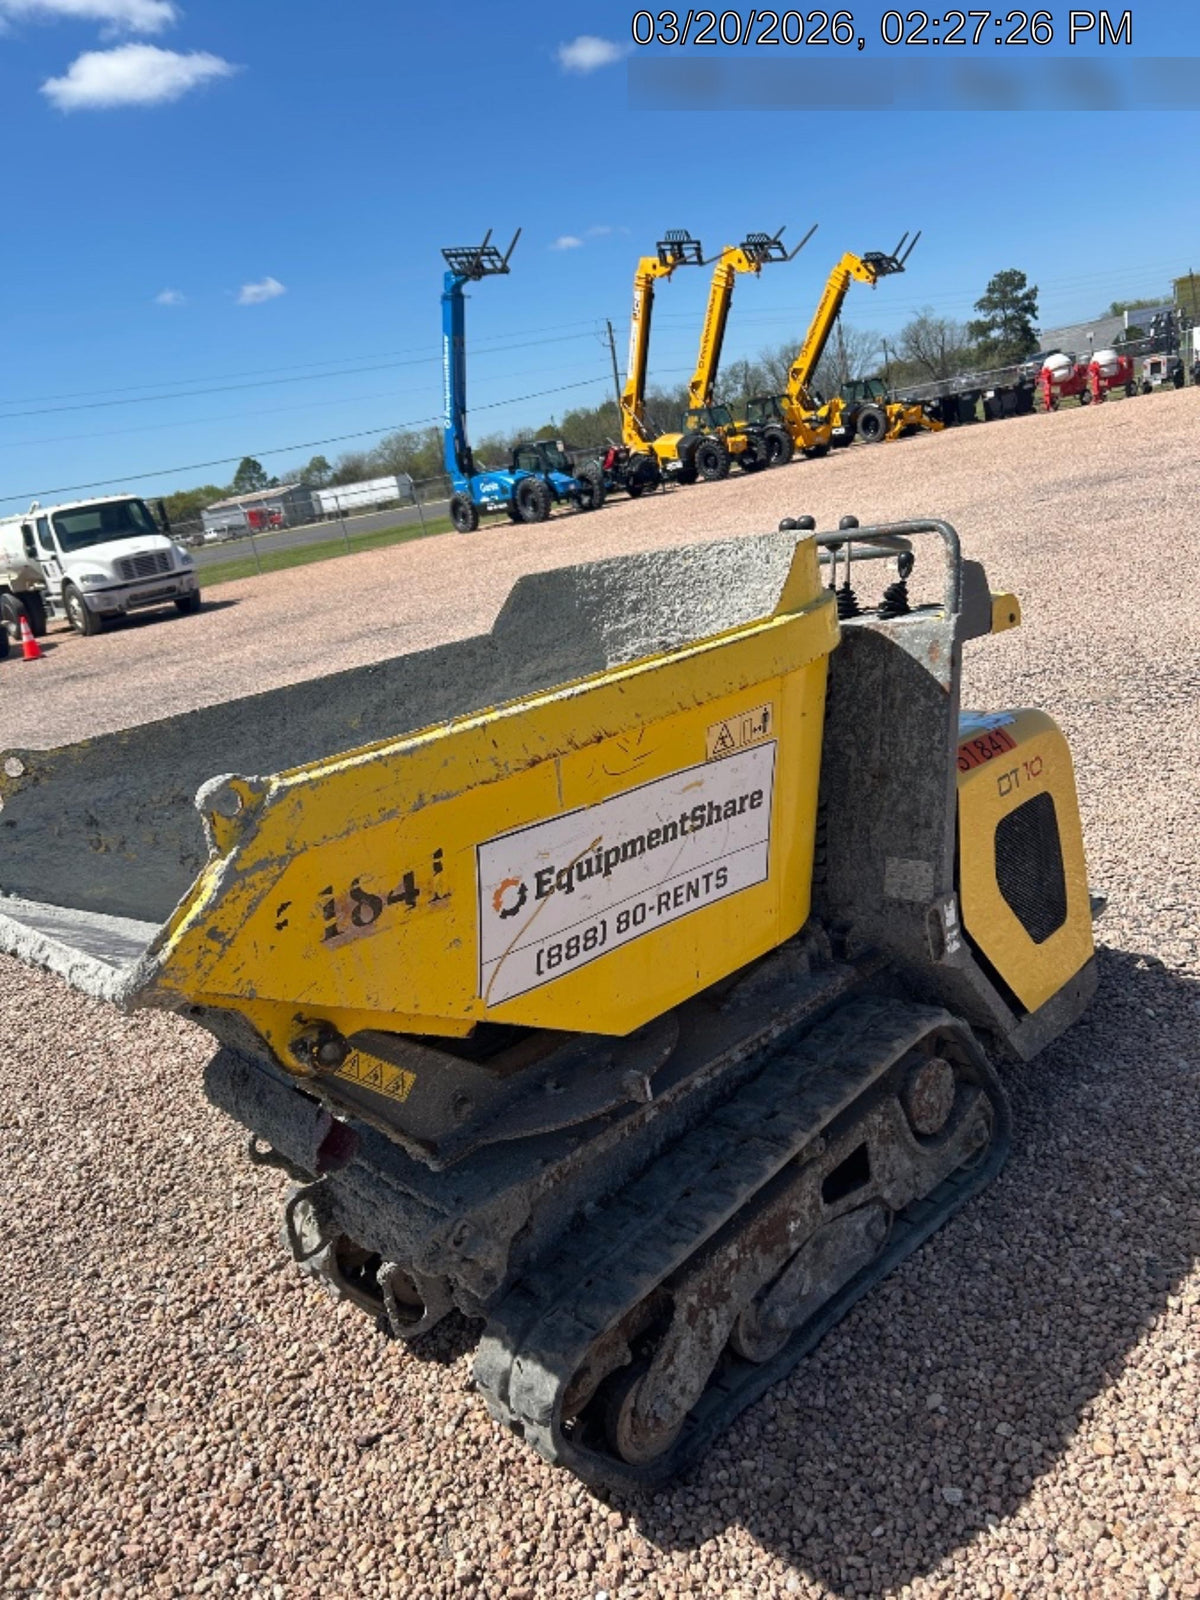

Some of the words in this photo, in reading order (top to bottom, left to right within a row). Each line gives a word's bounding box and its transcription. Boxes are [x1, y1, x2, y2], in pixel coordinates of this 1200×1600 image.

[533, 787, 764, 902] EquipmentShare
[536, 922, 608, 977] (888)
[616, 867, 729, 935] 80-RENTS
